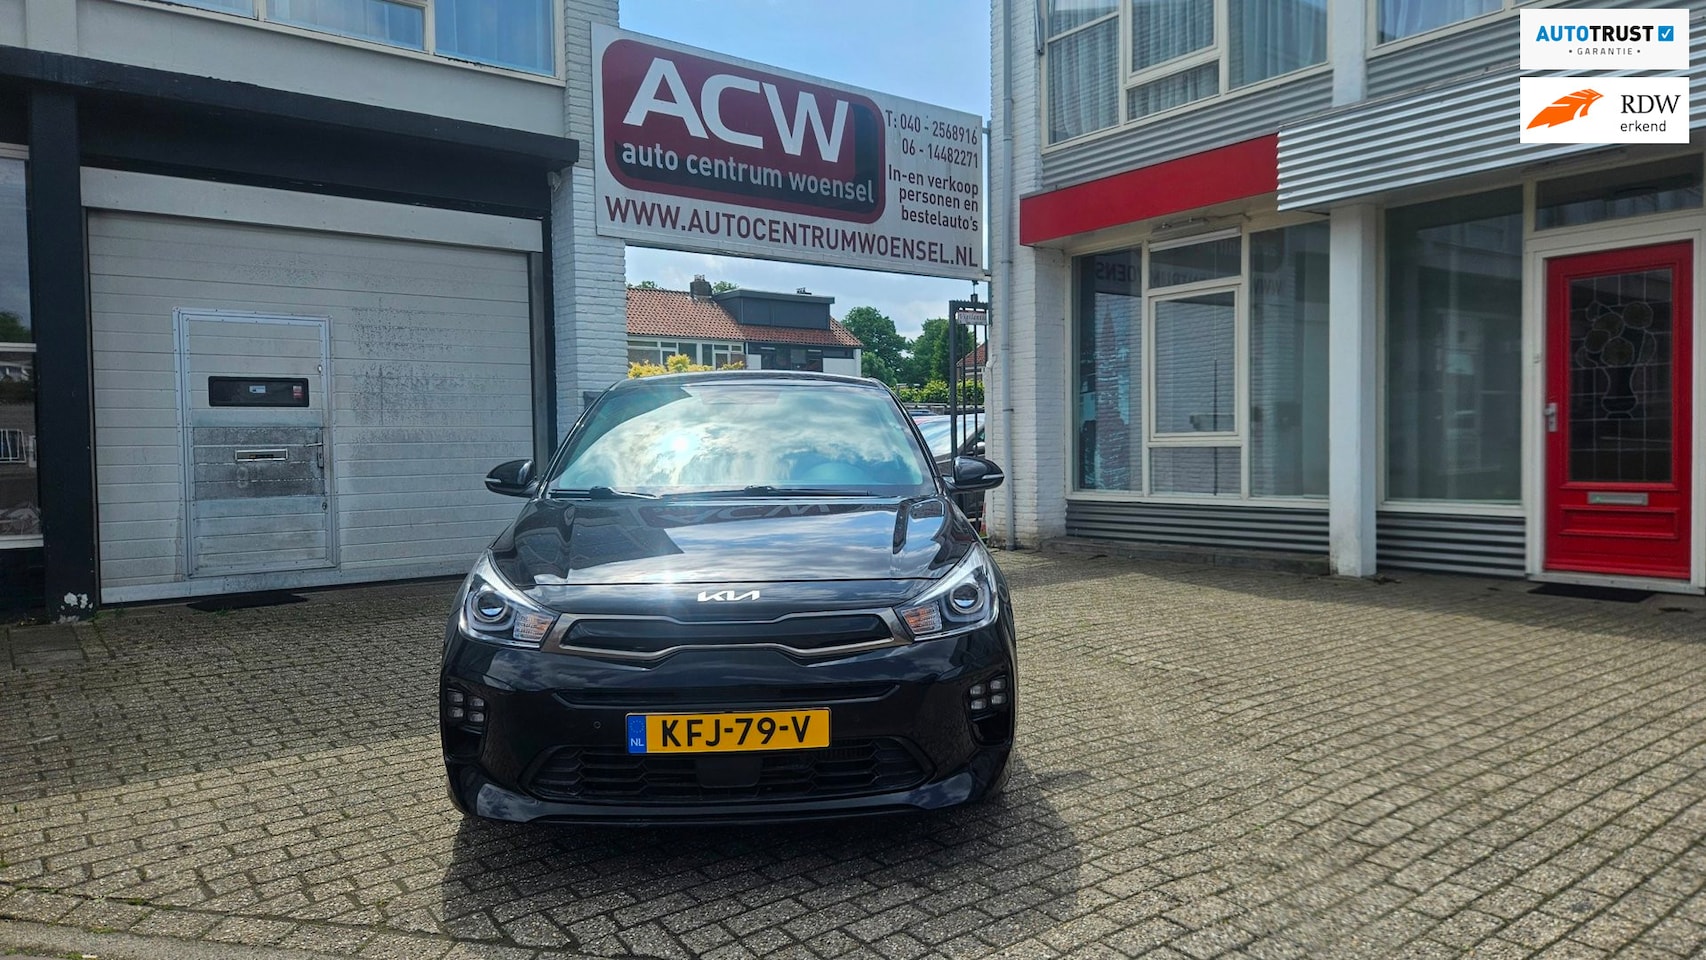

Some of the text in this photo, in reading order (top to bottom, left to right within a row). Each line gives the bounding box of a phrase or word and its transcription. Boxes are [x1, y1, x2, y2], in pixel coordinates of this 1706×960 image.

[622, 57, 849, 163] ACW
[900, 113, 921, 133] 040
[932, 120, 978, 146] 2568916
[902, 138, 916, 156] 06
[928, 143, 978, 169] 14482271
[622, 141, 875, 204] auto centrum woensel
[888, 164, 979, 199] In-en verkoop
[899, 187, 979, 212] personen en
[604, 195, 979, 268] WWW.AUTOCENTRUMWOENSEL.NL
[901, 205, 978, 232] bestelauto's
[630, 738, 645, 748] NL
[661, 715, 811, 748] KFJ-79-V
